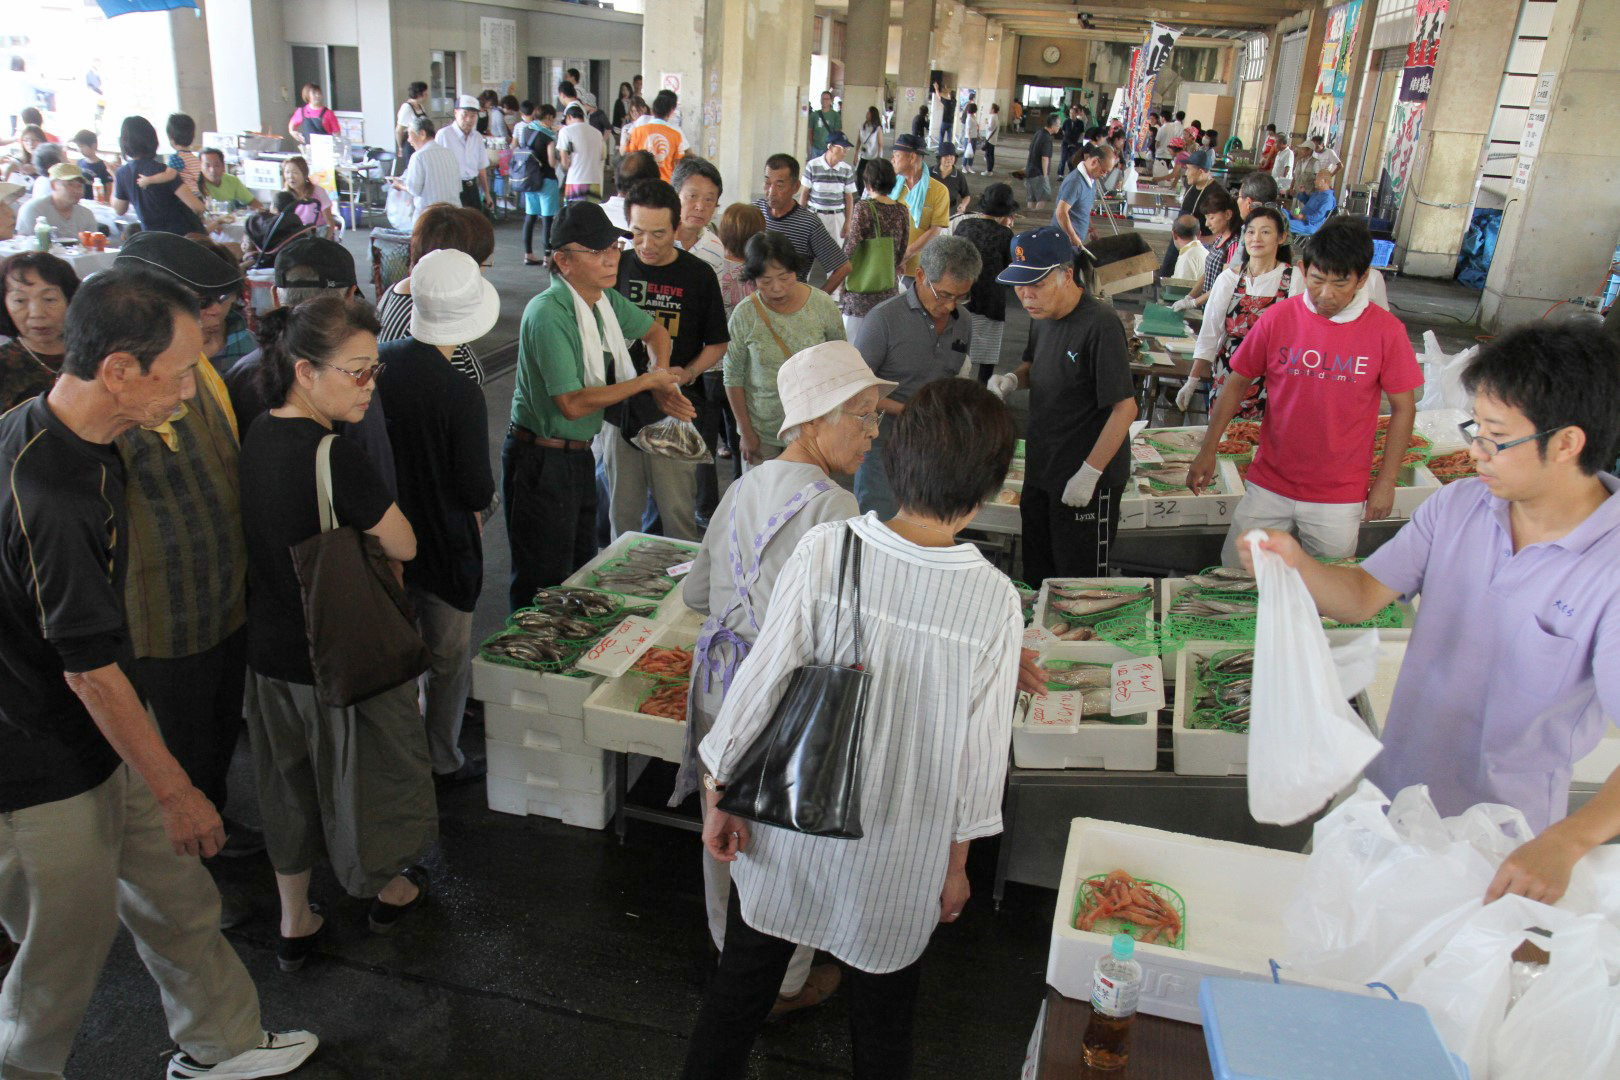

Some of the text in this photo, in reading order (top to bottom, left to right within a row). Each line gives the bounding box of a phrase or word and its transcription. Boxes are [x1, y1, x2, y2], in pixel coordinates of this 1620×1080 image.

[656, 294, 672, 302] MY
[1279, 346, 1369, 375] SVOLME
[1074, 512, 1096, 522] Lynx
